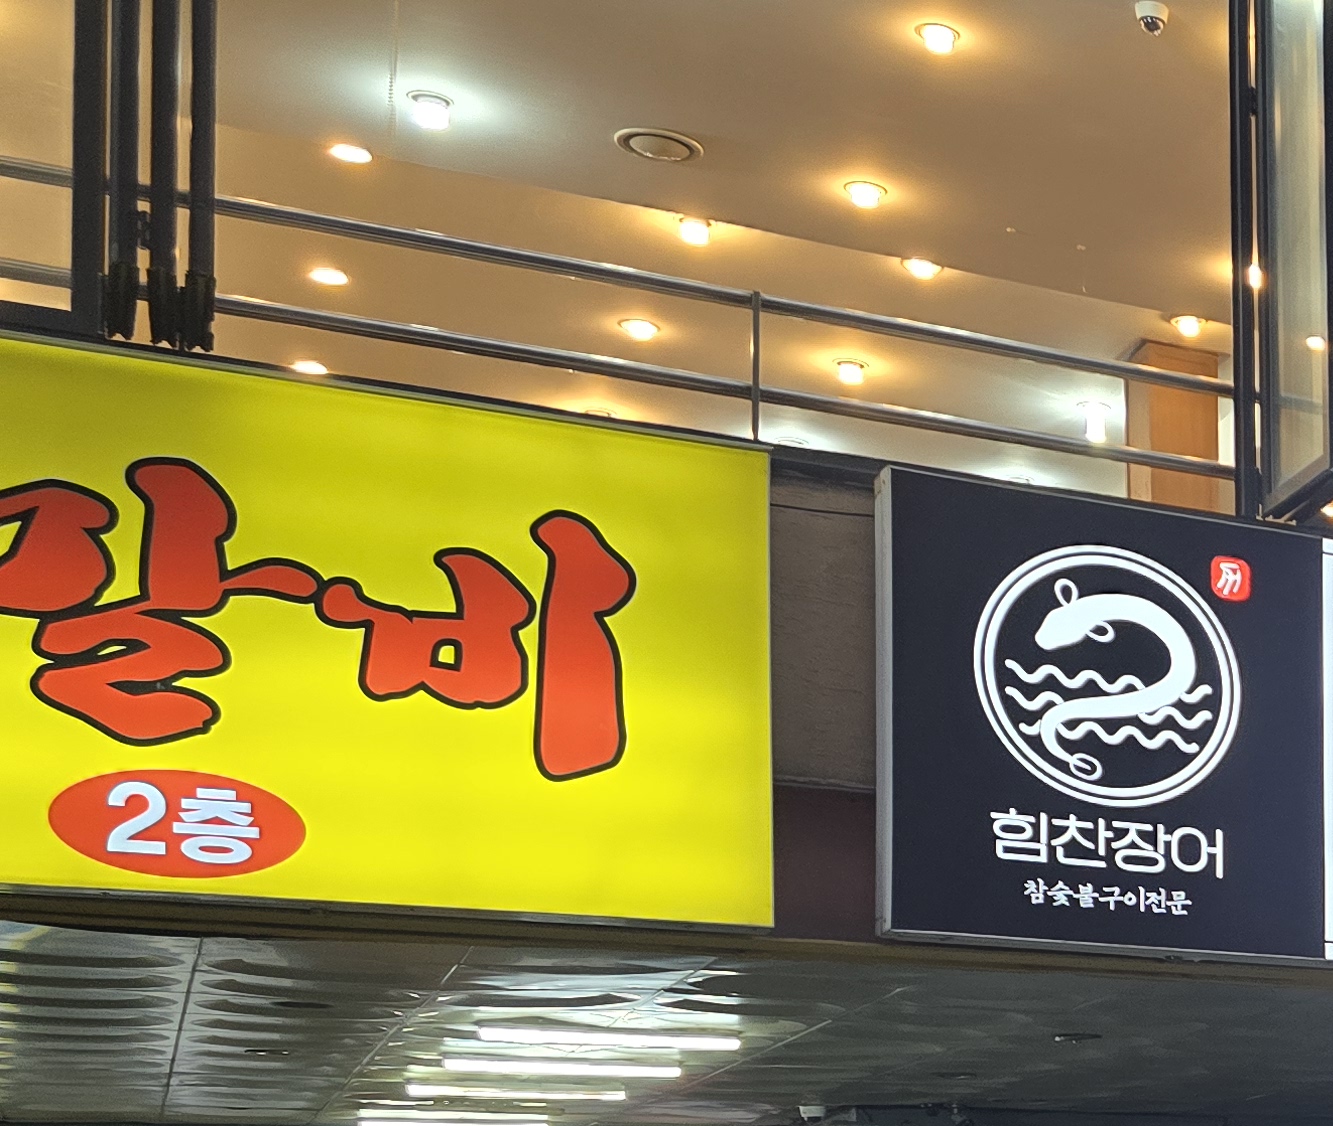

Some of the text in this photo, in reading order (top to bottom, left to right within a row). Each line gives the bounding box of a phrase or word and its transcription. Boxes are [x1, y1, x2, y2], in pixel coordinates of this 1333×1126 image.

[106, 779, 260, 866] 2층
[990, 807, 1225, 879] 힘찬장어
[1023, 878, 1193, 915] 참숯불구이전문
